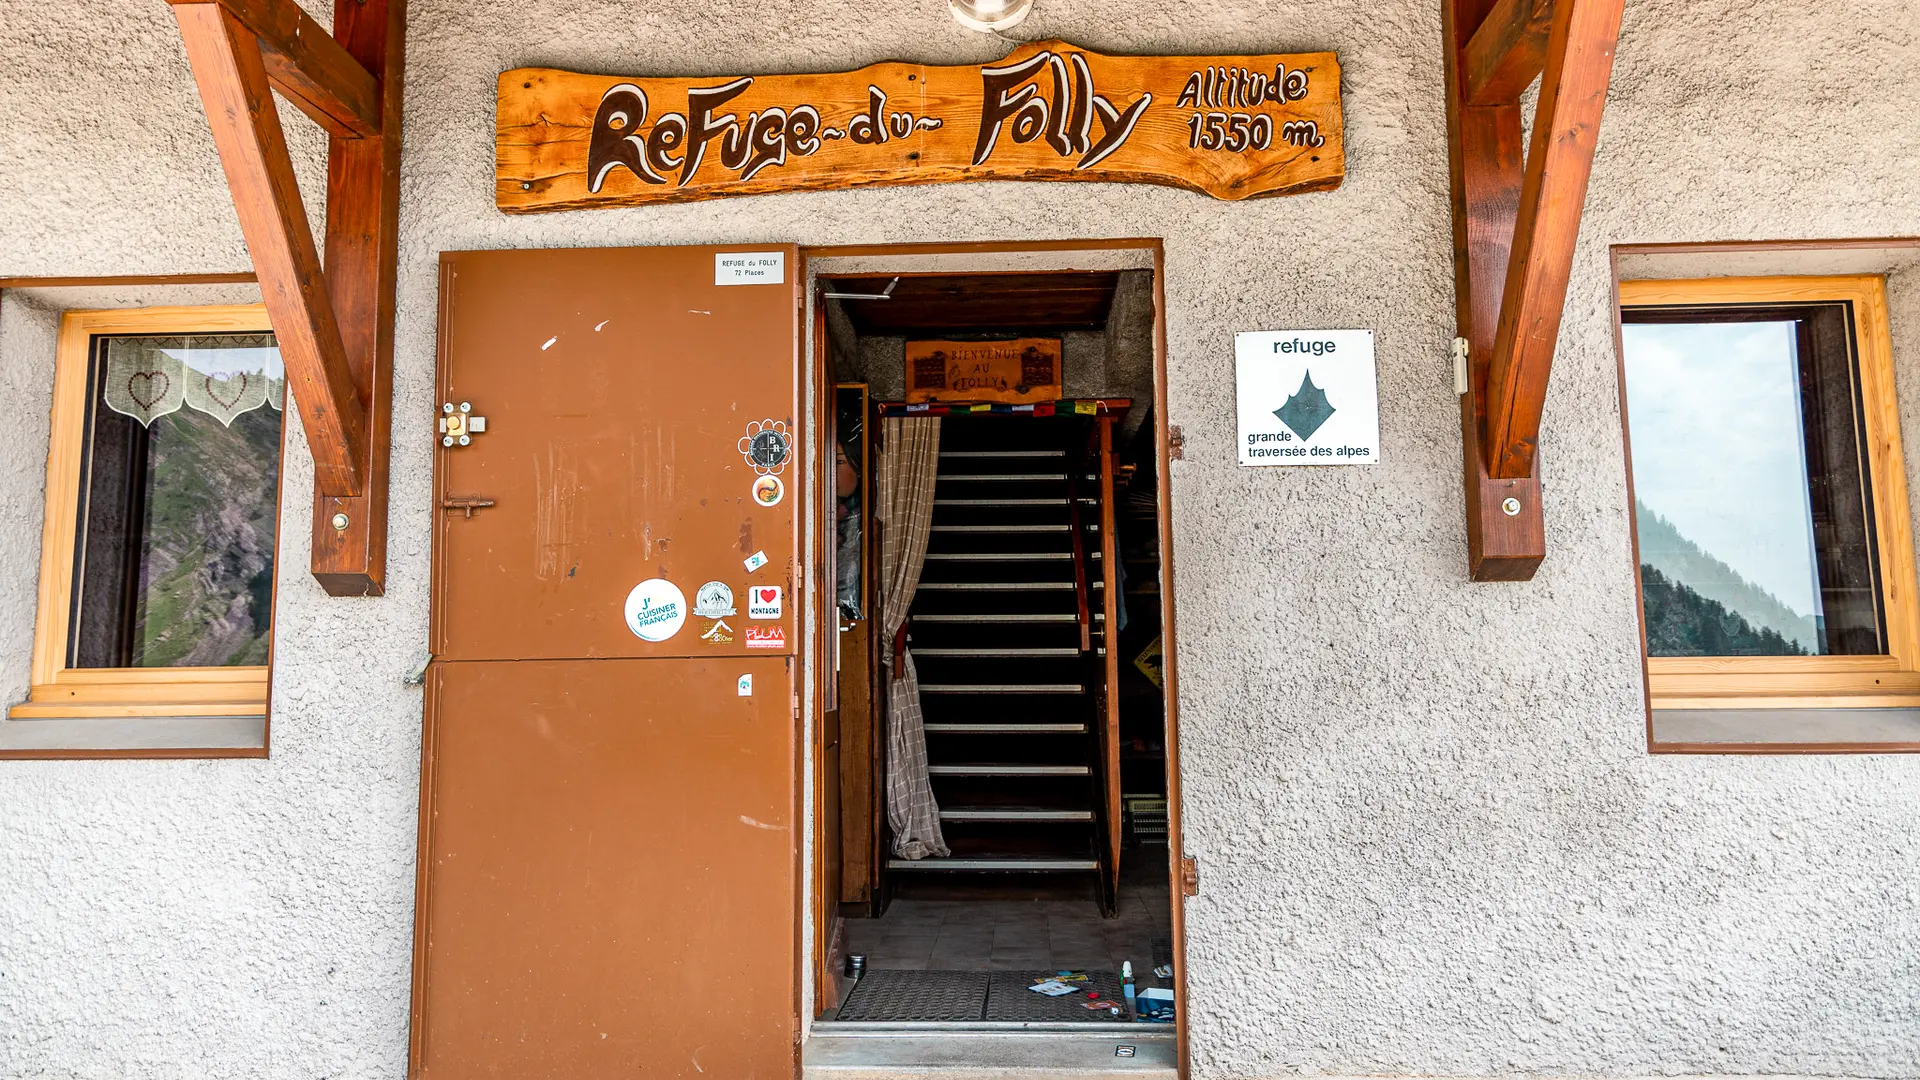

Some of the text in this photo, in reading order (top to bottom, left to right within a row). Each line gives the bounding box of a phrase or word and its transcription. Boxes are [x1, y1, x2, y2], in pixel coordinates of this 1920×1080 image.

[1177, 63, 1310, 108] Altitude
[972, 51, 1153, 170] Folly
[1188, 111, 1326, 152] 1550 m
[951, 348, 1018, 361] BIENVENUE
[1273, 337, 1336, 356] refuge
[973, 363, 991, 374] AU
[1247, 430, 1292, 445] grande
[1248, 445, 1370, 459] traversée des alpes
[754, 589, 759, 604] I
[637, 603, 676, 621] CUISINER
[639, 611, 678, 628] FRANÇAIS
[745, 628, 786, 640] PLUM
